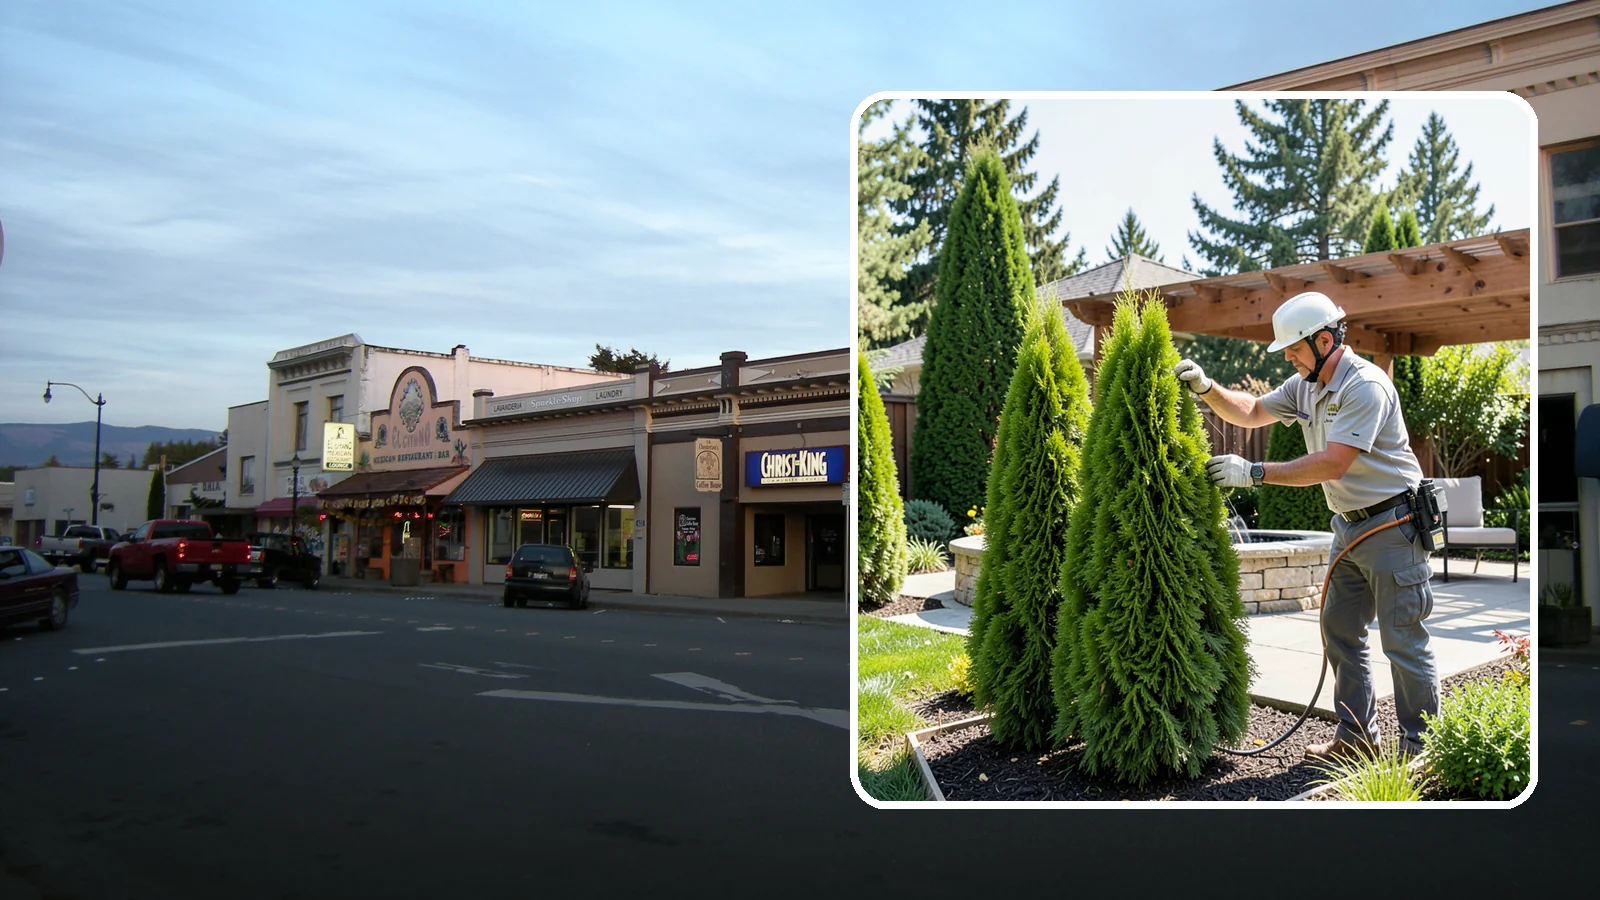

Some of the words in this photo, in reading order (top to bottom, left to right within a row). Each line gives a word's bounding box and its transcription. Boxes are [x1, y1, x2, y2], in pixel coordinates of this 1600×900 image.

[595, 388, 624, 400] LAUNDRY
[493, 402, 522, 412] LAVANDERIA
[530, 397, 562, 409] Sparkle
[562, 394, 582, 404] Shop
[392, 425, 401, 449] EL
[373, 455, 396, 464] MEXICAN
[397, 451, 434, 462] RESTAURANT
[438, 450, 450, 459] BAR
[761, 452, 797, 478] CHRIST
[799, 449, 827, 476] KING
